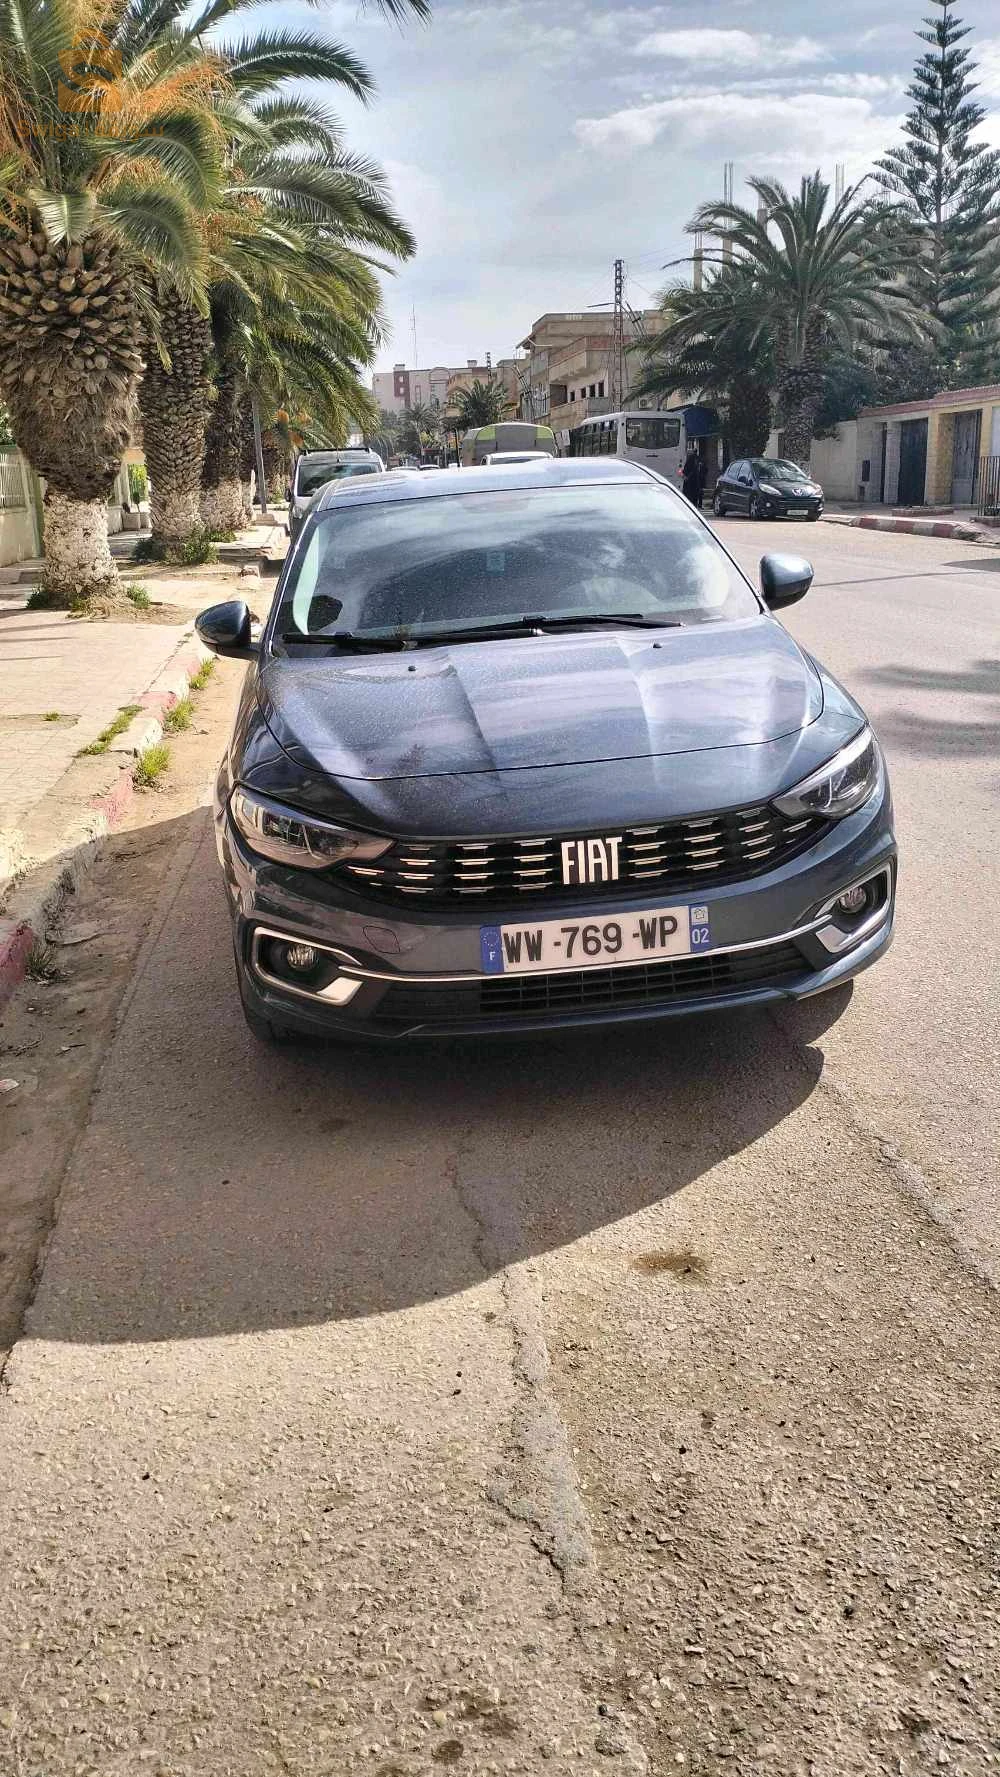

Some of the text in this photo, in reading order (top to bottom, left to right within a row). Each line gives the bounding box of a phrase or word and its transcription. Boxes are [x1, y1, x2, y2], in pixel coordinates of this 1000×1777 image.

[561, 836, 623, 885] FIAT
[691, 927, 710, 944] 02
[489, 951, 497, 961] F
